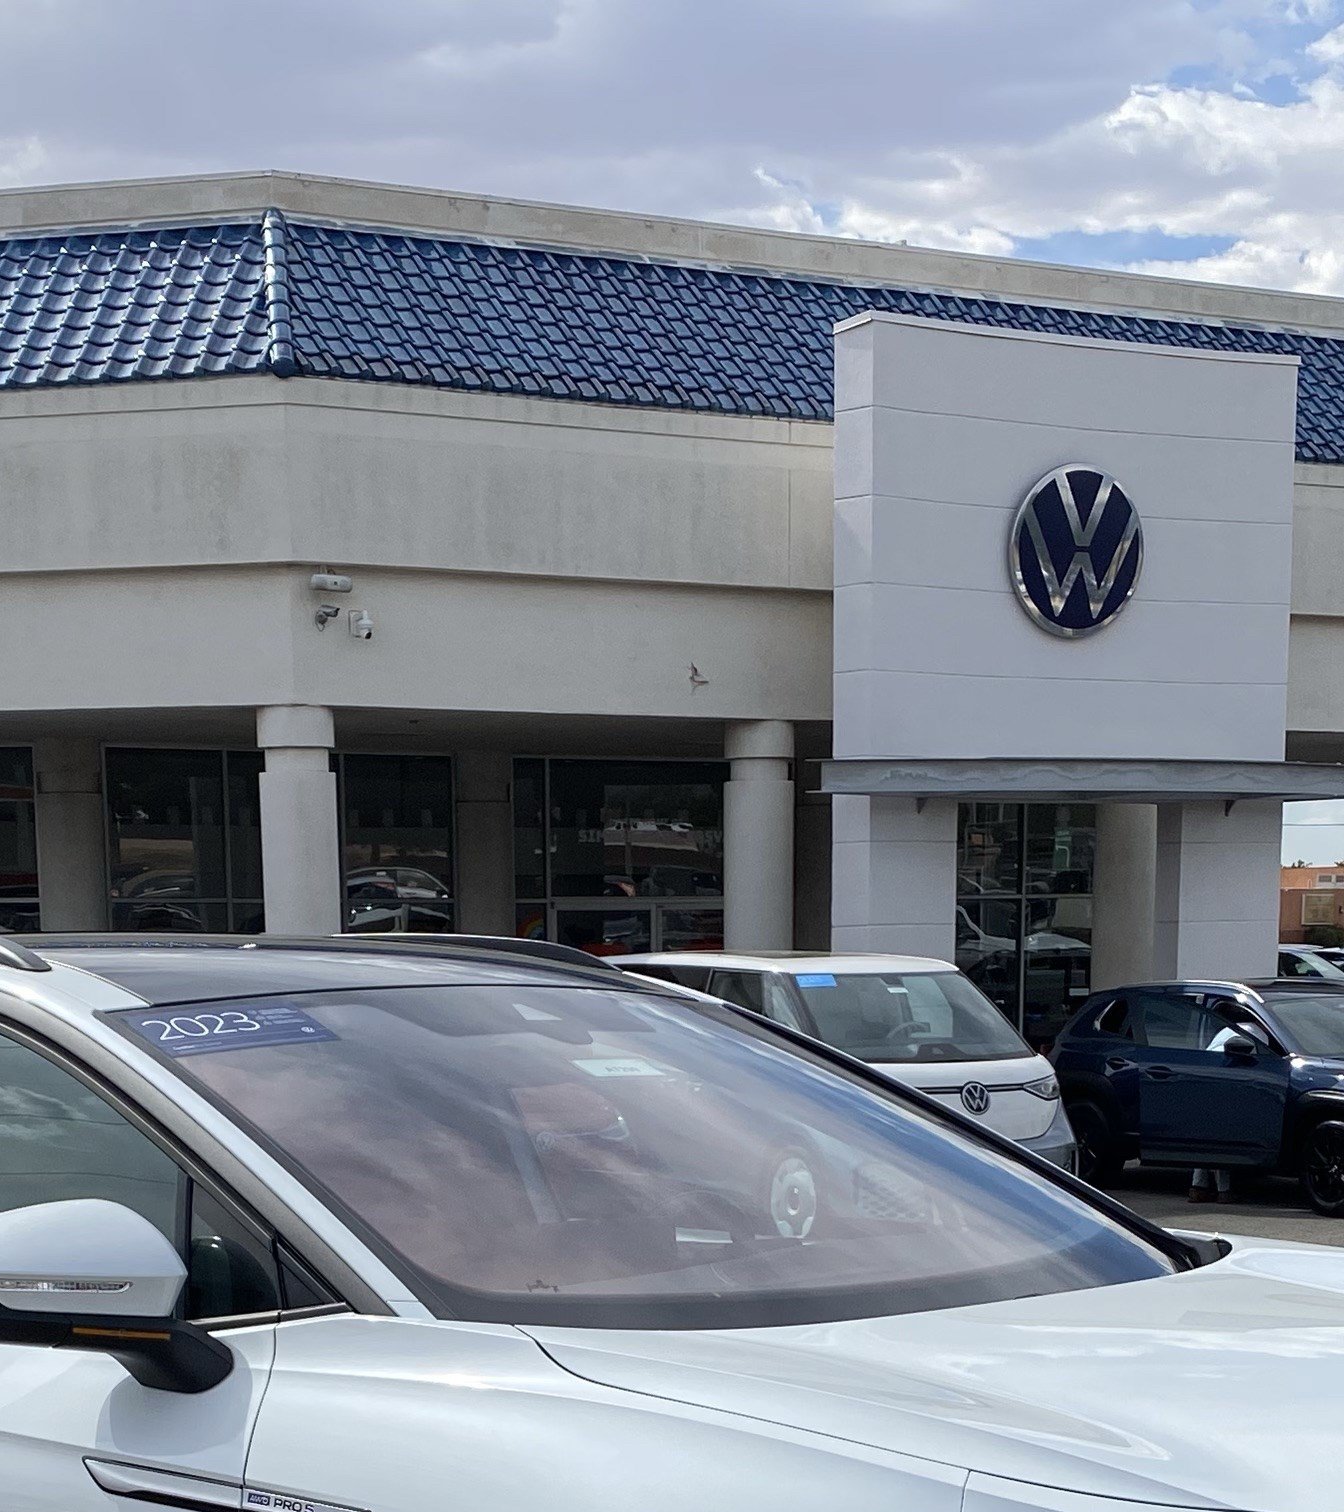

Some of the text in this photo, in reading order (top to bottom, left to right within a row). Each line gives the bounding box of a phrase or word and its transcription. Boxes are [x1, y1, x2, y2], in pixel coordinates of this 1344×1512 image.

[1009, 462, 1144, 639] VW
[141, 1012, 261, 1041] 2023
[962, 1083, 989, 1115] VW
[249, 1494, 270, 1505] AWD
[274, 1498, 302, 1512] PRO
